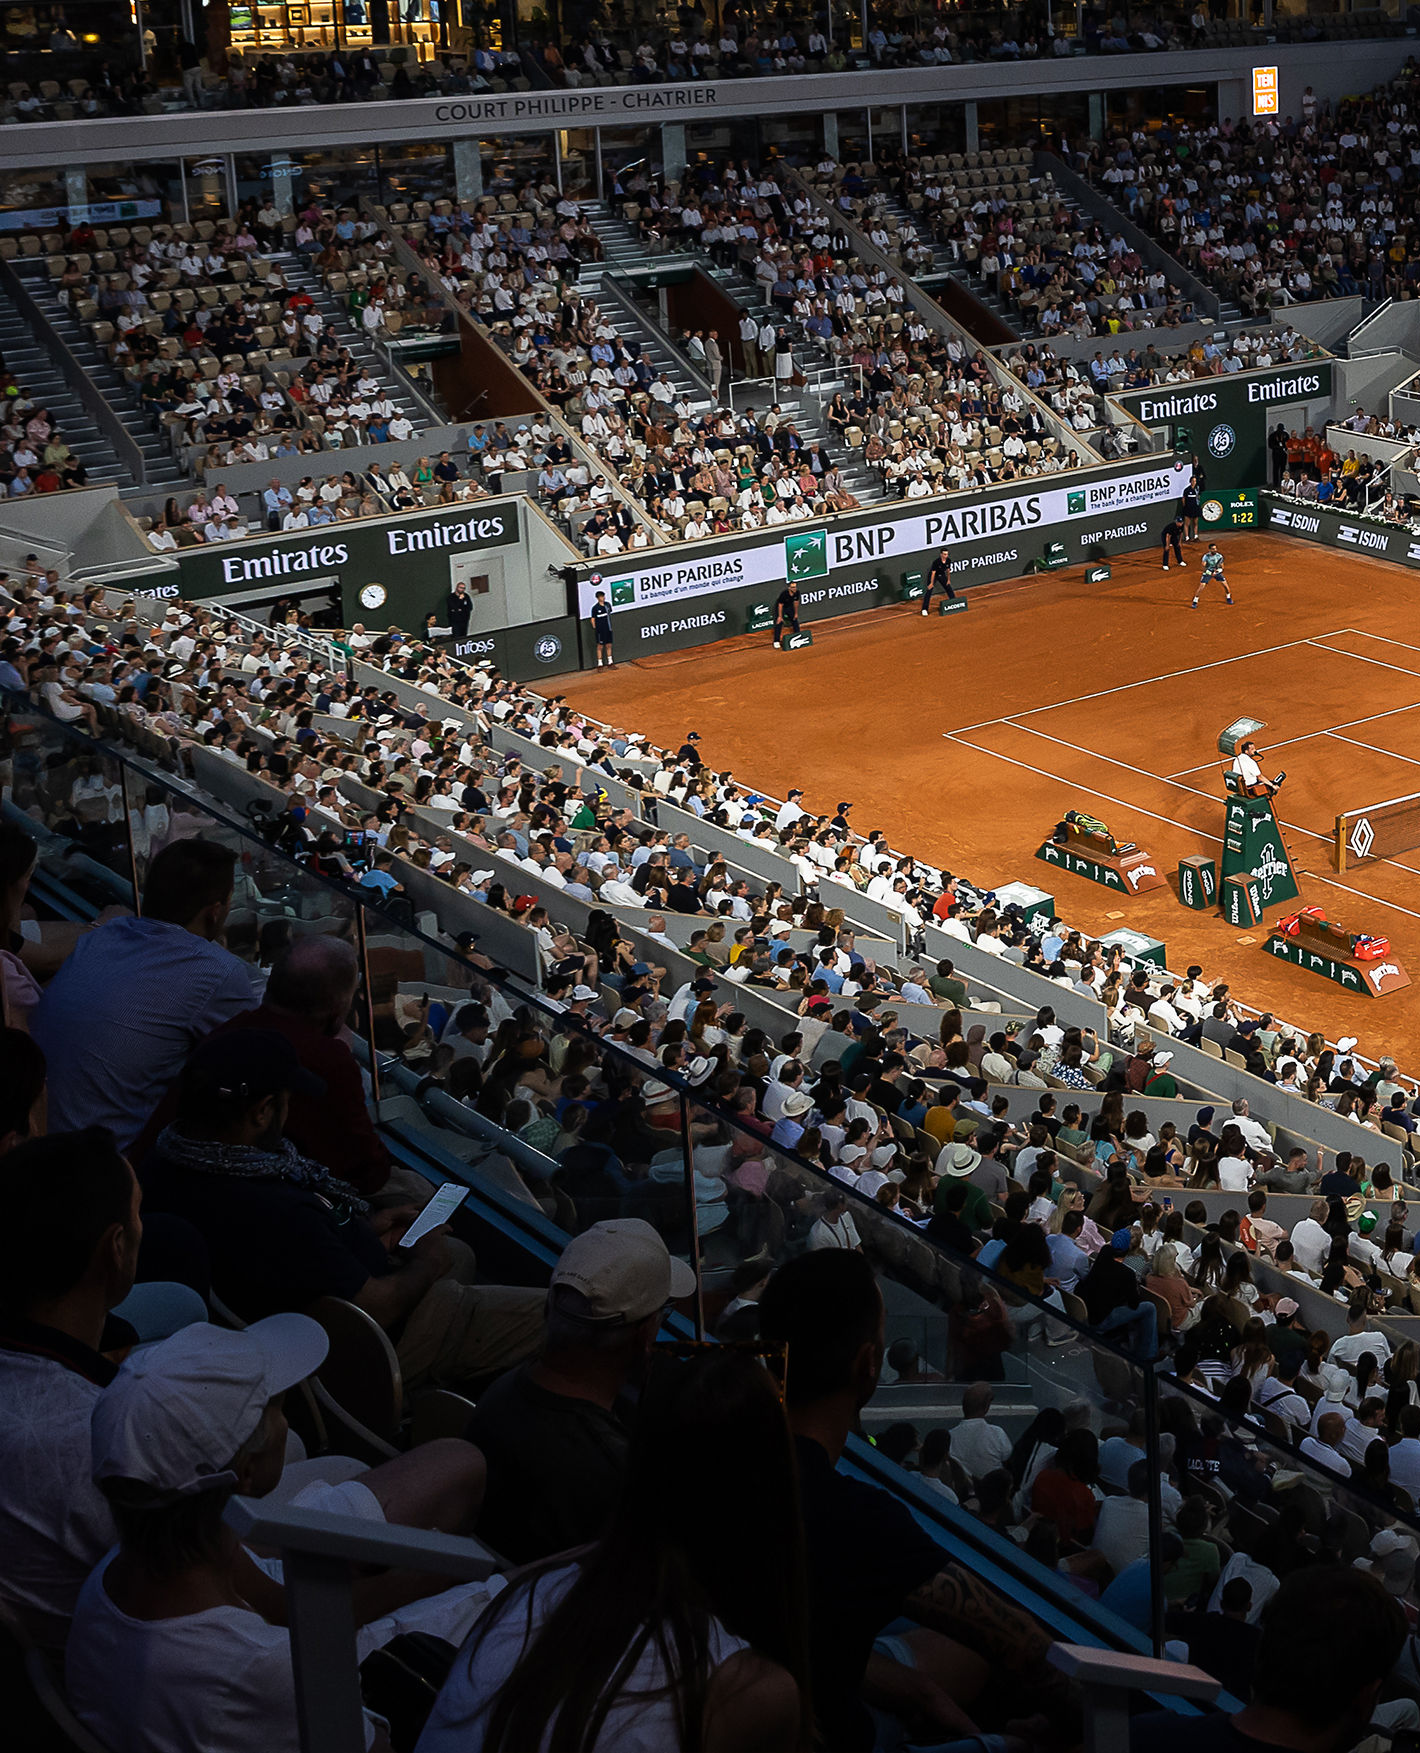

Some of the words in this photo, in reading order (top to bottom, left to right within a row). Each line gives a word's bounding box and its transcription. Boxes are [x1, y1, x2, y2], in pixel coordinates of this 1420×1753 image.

[435, 102, 507, 121] COURT
[515, 95, 604, 116] PHILIPPE
[622, 89, 717, 108] CHATRIER
[1248, 375, 1320, 403] Emirates
[1140, 392, 1217, 421] Emirates
[1090, 486, 1116, 502] BNP
[1119, 474, 1170, 496] PARIBAS
[835, 527, 895, 563] BNP
[925, 497, 1042, 544] PARIBAS
[1232, 512, 1253, 523] 1:22
[1291, 513, 1320, 533] ISDIN
[387, 517, 504, 555] Emirates
[1081, 531, 1103, 546] BNP
[1104, 522, 1148, 541] PARIBAS
[1358, 530, 1389, 550] ISDIN
[222, 544, 348, 584] Emirates
[640, 573, 673, 591] BNP
[677, 558, 742, 584] PARIBAS
[950, 559, 969, 573] BNP
[971, 549, 1018, 568] PARIBAS
[801, 590, 826, 605] BNP
[828, 578, 878, 599] PARIBAS
[641, 623, 668, 639] BNP
[671, 611, 726, 632] PARIBAS
[752, 620, 774, 630] LACOSTE
[455, 638, 496, 656] Infosys
[1231, 890, 1239, 924] Wilson
